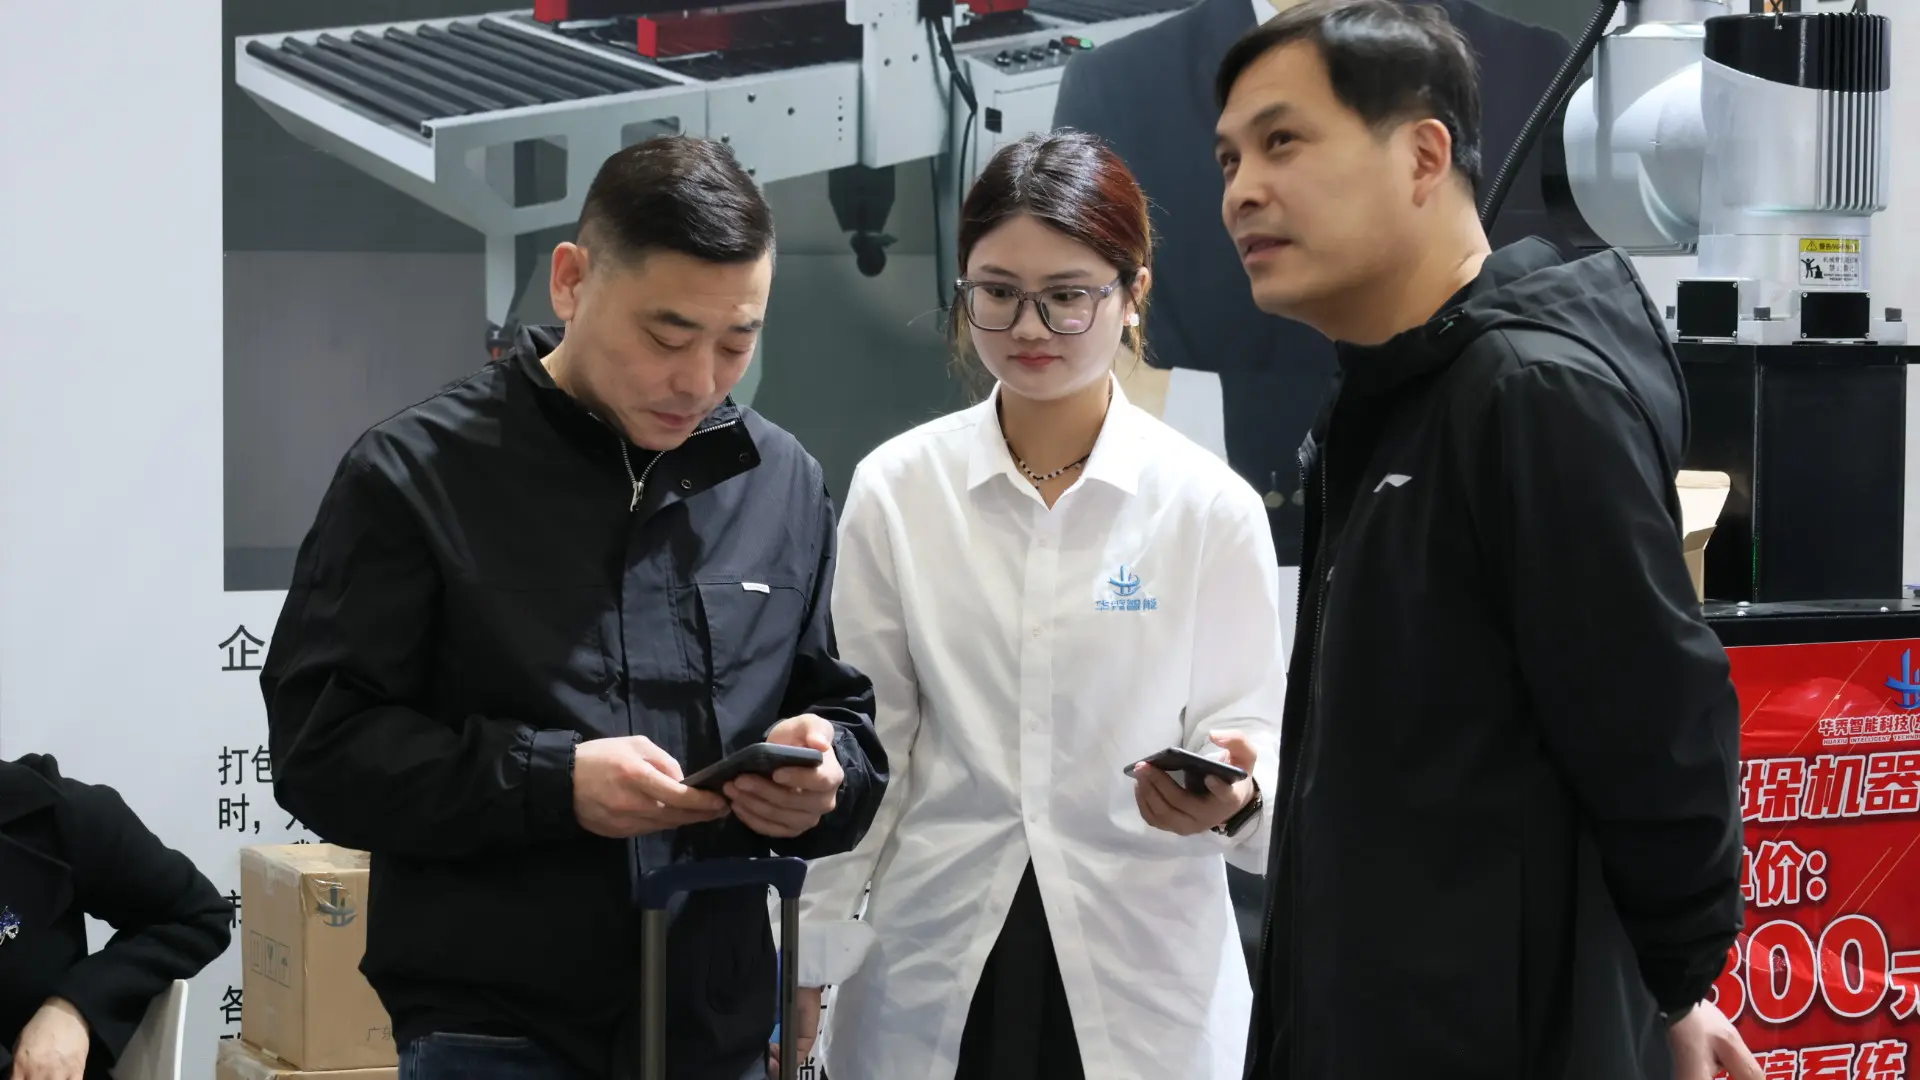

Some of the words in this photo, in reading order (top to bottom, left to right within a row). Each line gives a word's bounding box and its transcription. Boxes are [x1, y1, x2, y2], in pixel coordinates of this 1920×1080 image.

[218, 624, 265, 671] 企
[1740, 751, 1920, 822] 垛机器
